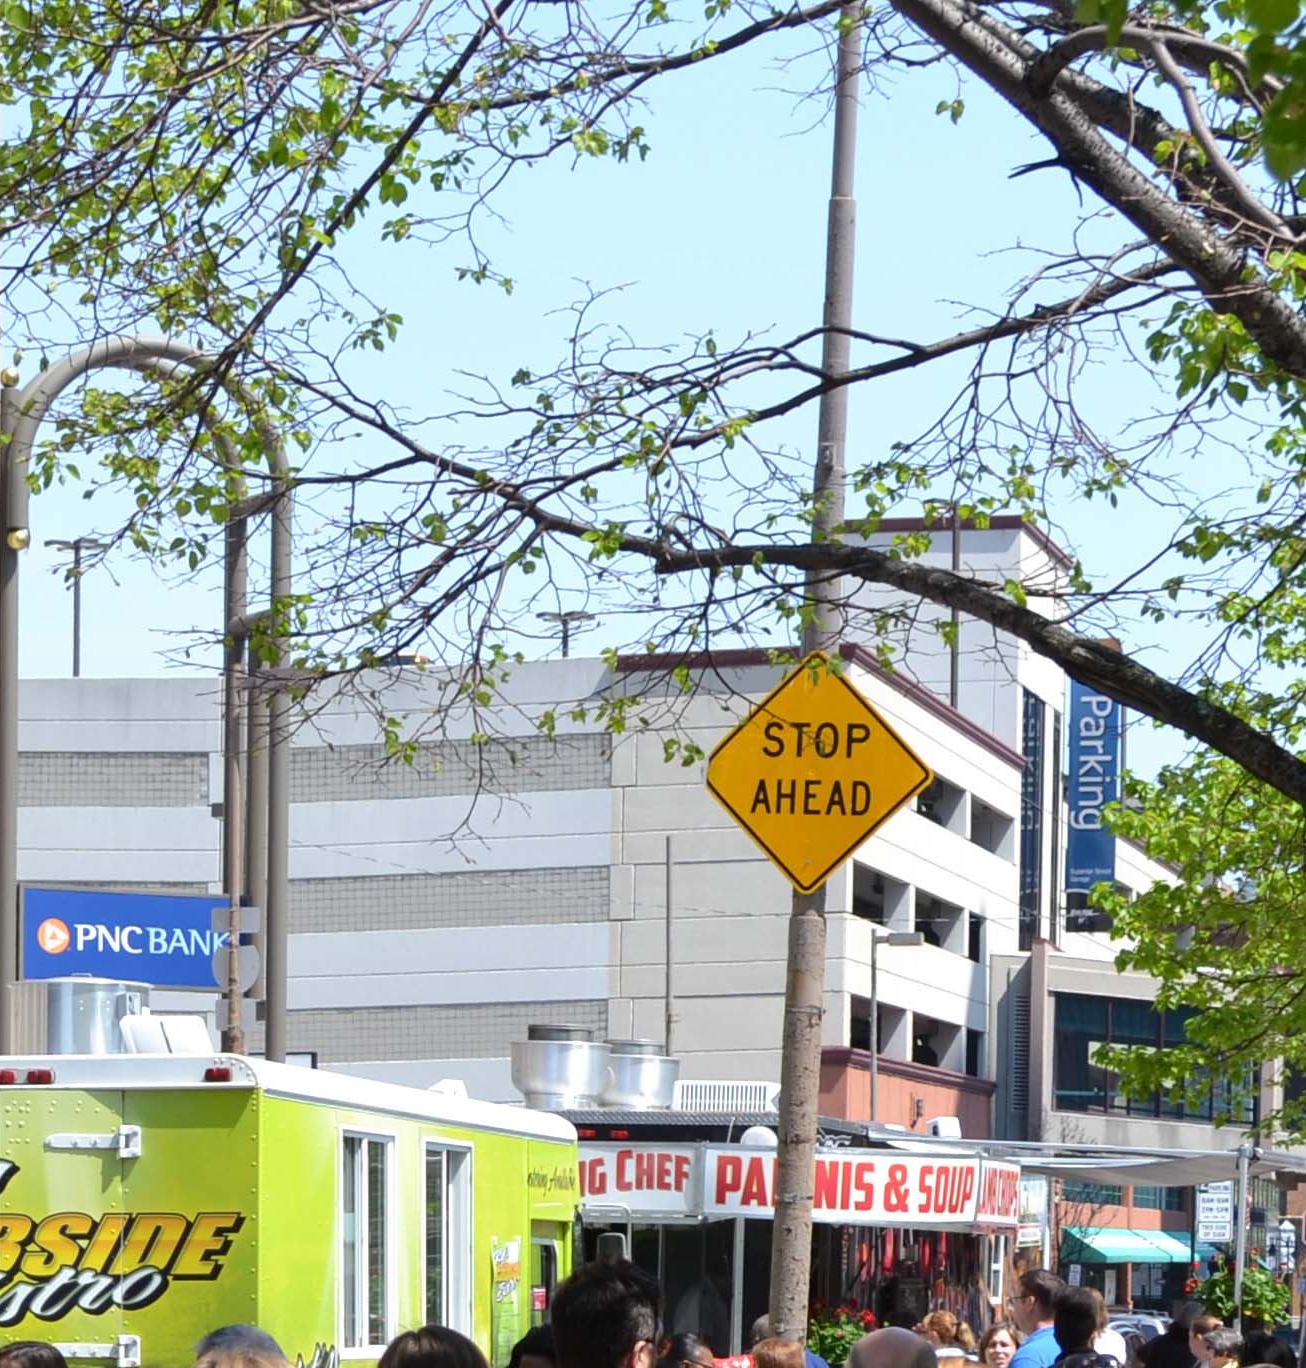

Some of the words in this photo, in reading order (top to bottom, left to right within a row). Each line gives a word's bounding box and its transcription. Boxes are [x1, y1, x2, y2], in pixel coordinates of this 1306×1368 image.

[762, 721, 871, 758] STOP
[1070, 696, 1112, 830] Parking
[750, 778, 871, 816] AHEAD
[74, 923, 142, 954] PNC
[146, 926, 232, 956] BANK
[616, 1149, 691, 1192] CHEF
[715, 1155, 874, 1212] PANIS
[883, 1163, 910, 1213] &
[918, 1164, 975, 1214] SOUP
